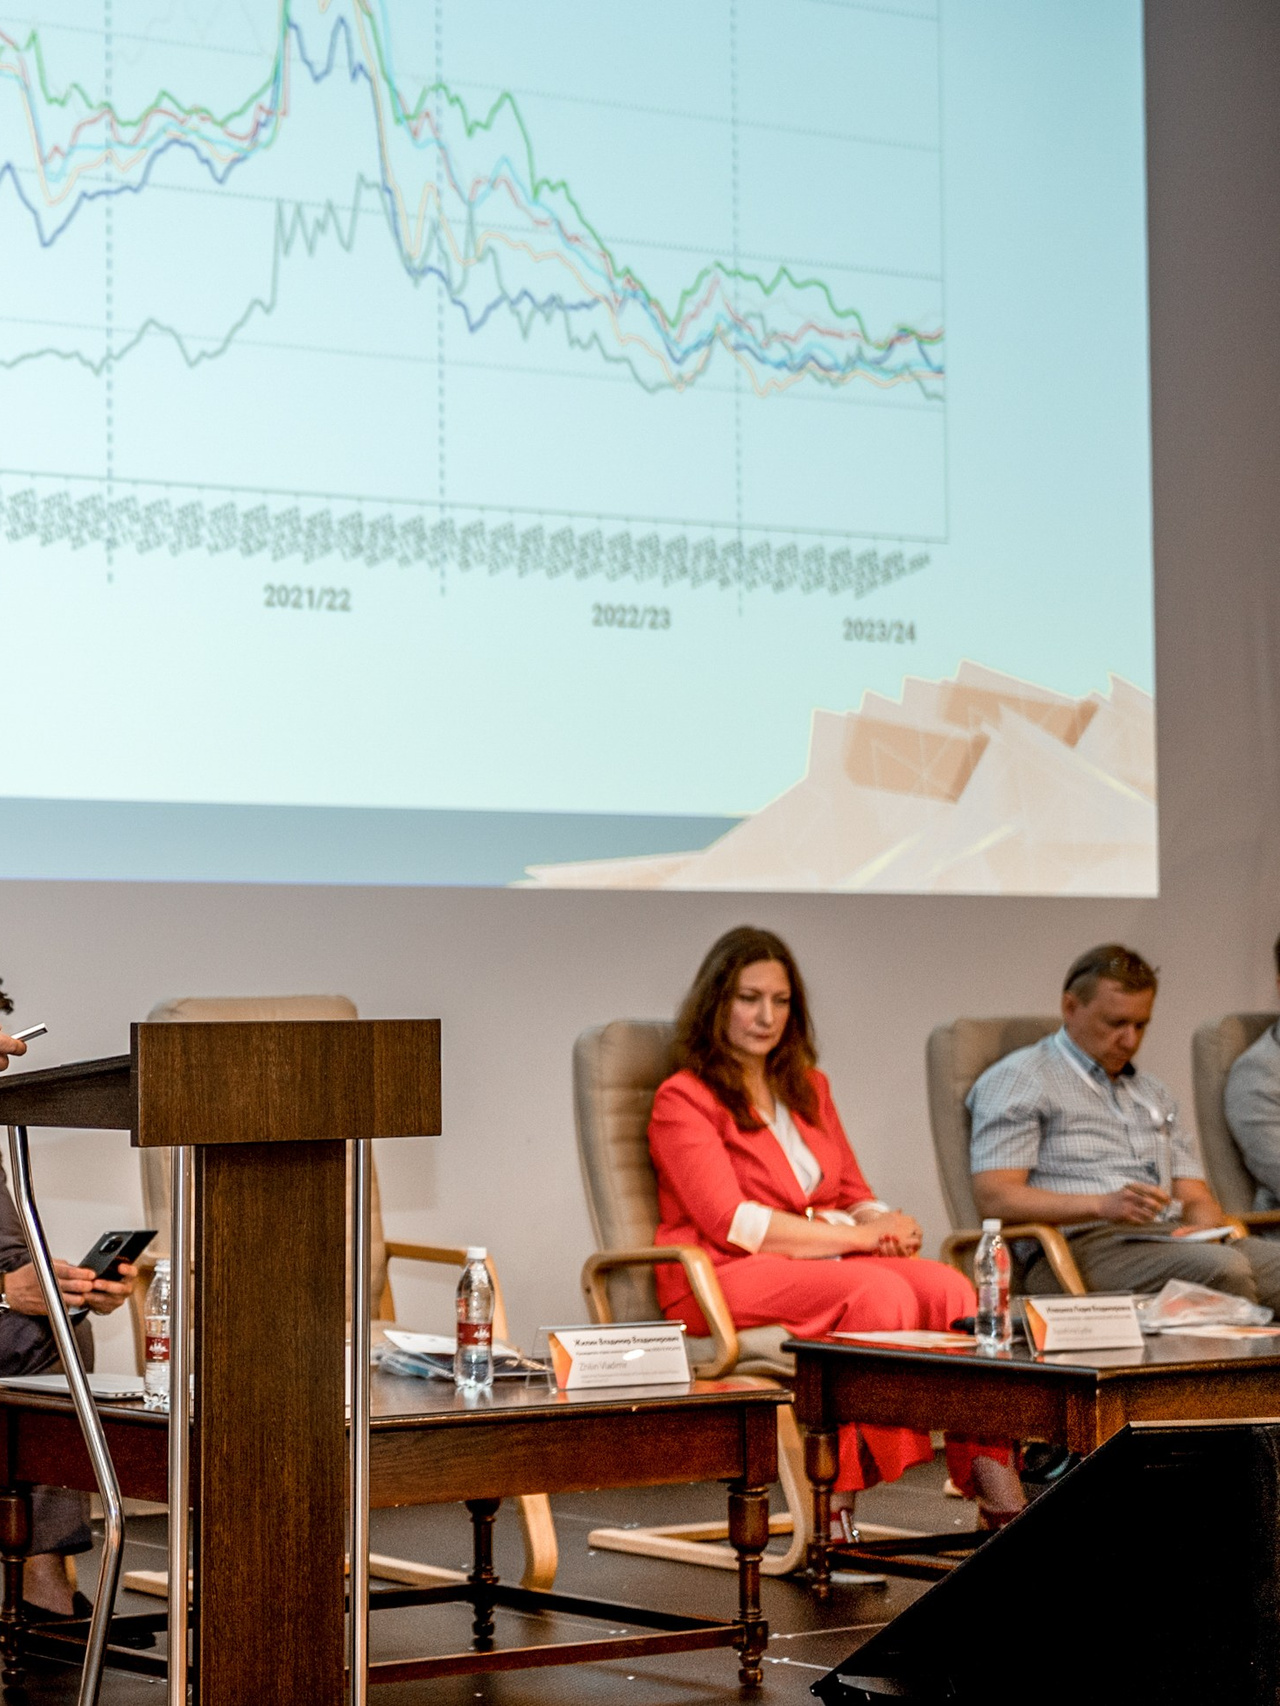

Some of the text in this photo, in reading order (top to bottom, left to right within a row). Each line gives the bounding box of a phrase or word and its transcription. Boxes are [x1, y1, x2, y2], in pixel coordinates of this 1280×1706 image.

[263, 583, 352, 612] 2021/22
[591, 602, 673, 631] 2022/23
[842, 616, 918, 645] 2023/24
